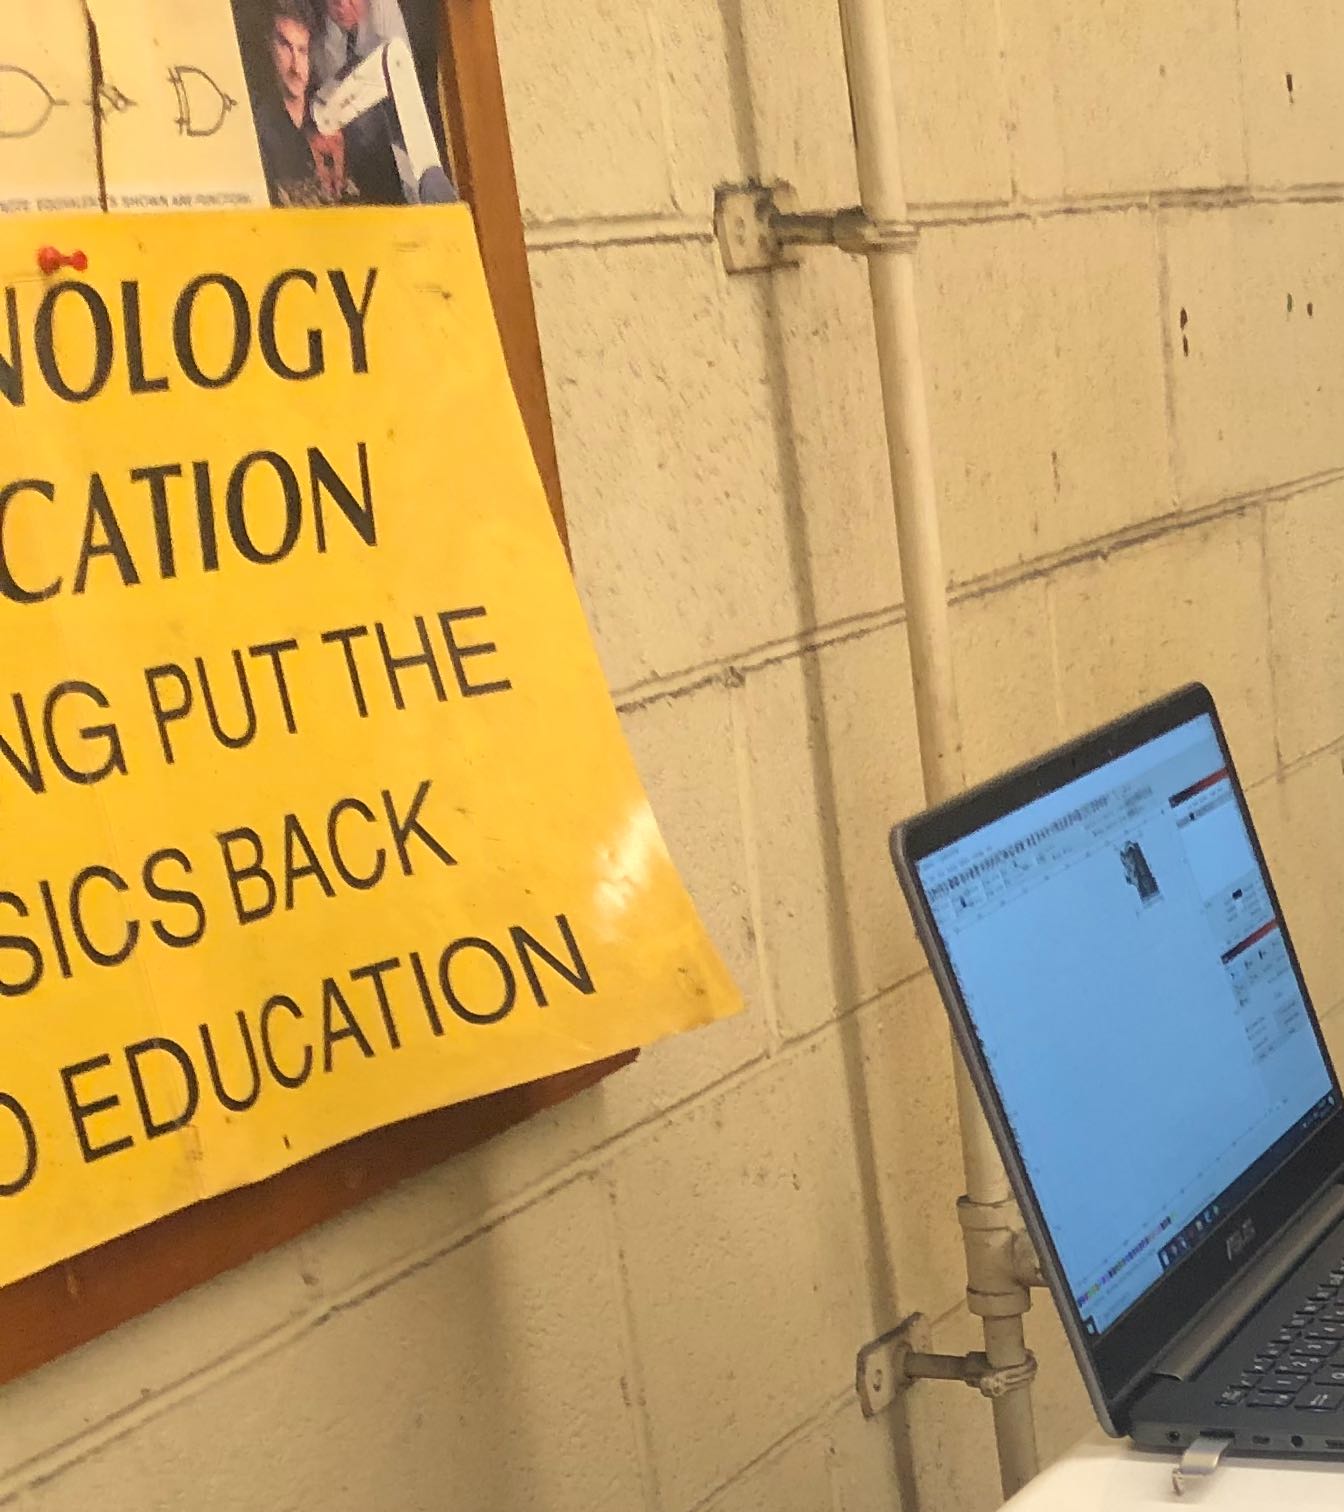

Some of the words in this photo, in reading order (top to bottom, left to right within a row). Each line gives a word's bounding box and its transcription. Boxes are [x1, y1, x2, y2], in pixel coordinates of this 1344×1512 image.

[0, 442, 378, 604] CATION
[145, 639, 299, 765] PUT
[321, 607, 512, 718] THE
[216, 781, 458, 926] BACK
[61, 914, 597, 1164] EDUCATION
